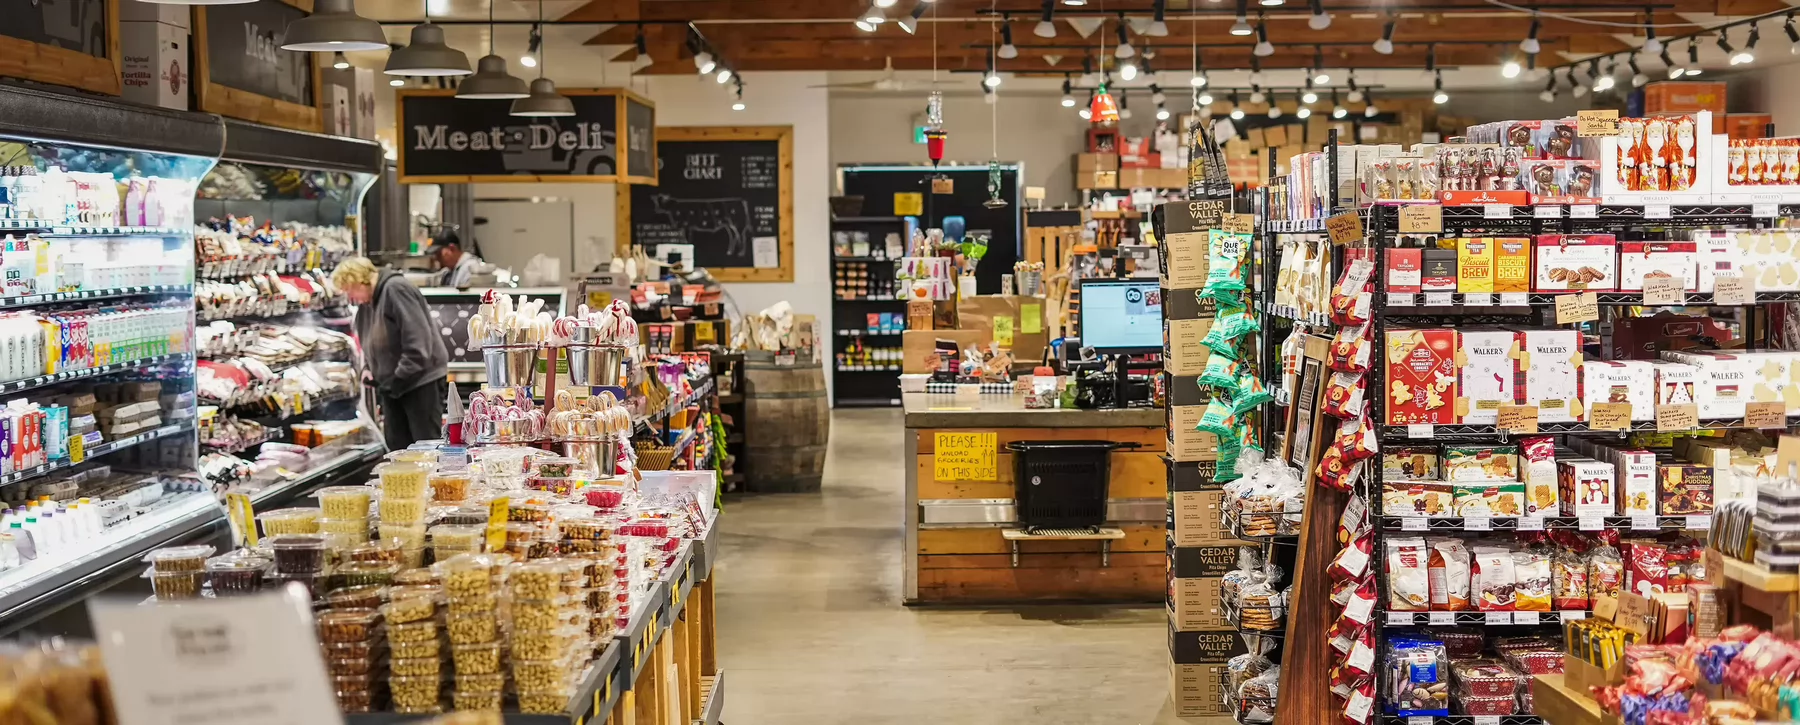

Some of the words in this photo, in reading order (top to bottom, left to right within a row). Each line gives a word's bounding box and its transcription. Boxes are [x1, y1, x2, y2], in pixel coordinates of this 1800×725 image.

[124, 56, 149, 64] Original
[121, 71, 151, 79] Tortilla
[414, 124, 505, 150] Meat
[530, 123, 604, 150] Deli
[684, 168, 724, 180] CHART
[1189, 200, 1224, 211] CEDAR
[1190, 209, 1224, 219] VALLEY
[1460, 256, 1490, 266] Biscuit
[1462, 268, 1489, 278] BREW
[1498, 268, 1525, 278] BREW
[1473, 347, 1504, 355] WALKER'S
[1711, 371, 1744, 380] WALKER'S
[937, 467, 948, 478] ON
[952, 467, 970, 478] THIS
[975, 466, 995, 478] SIDE
